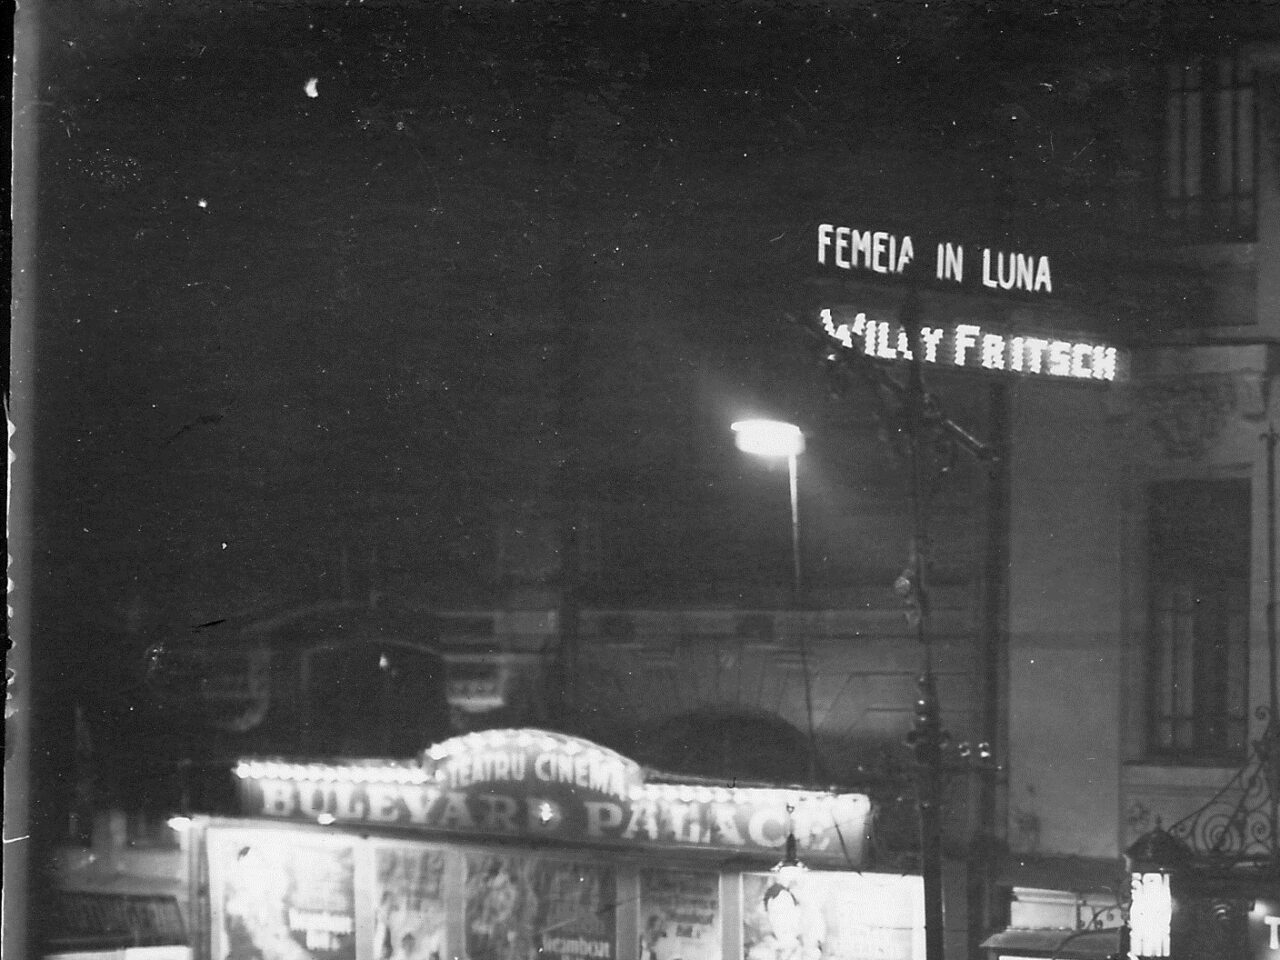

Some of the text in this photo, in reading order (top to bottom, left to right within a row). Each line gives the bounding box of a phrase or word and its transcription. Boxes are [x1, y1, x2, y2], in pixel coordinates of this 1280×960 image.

[818, 224, 1052, 293] FEMEIA IN LUNA
[954, 324, 1117, 381] FRITSCH
